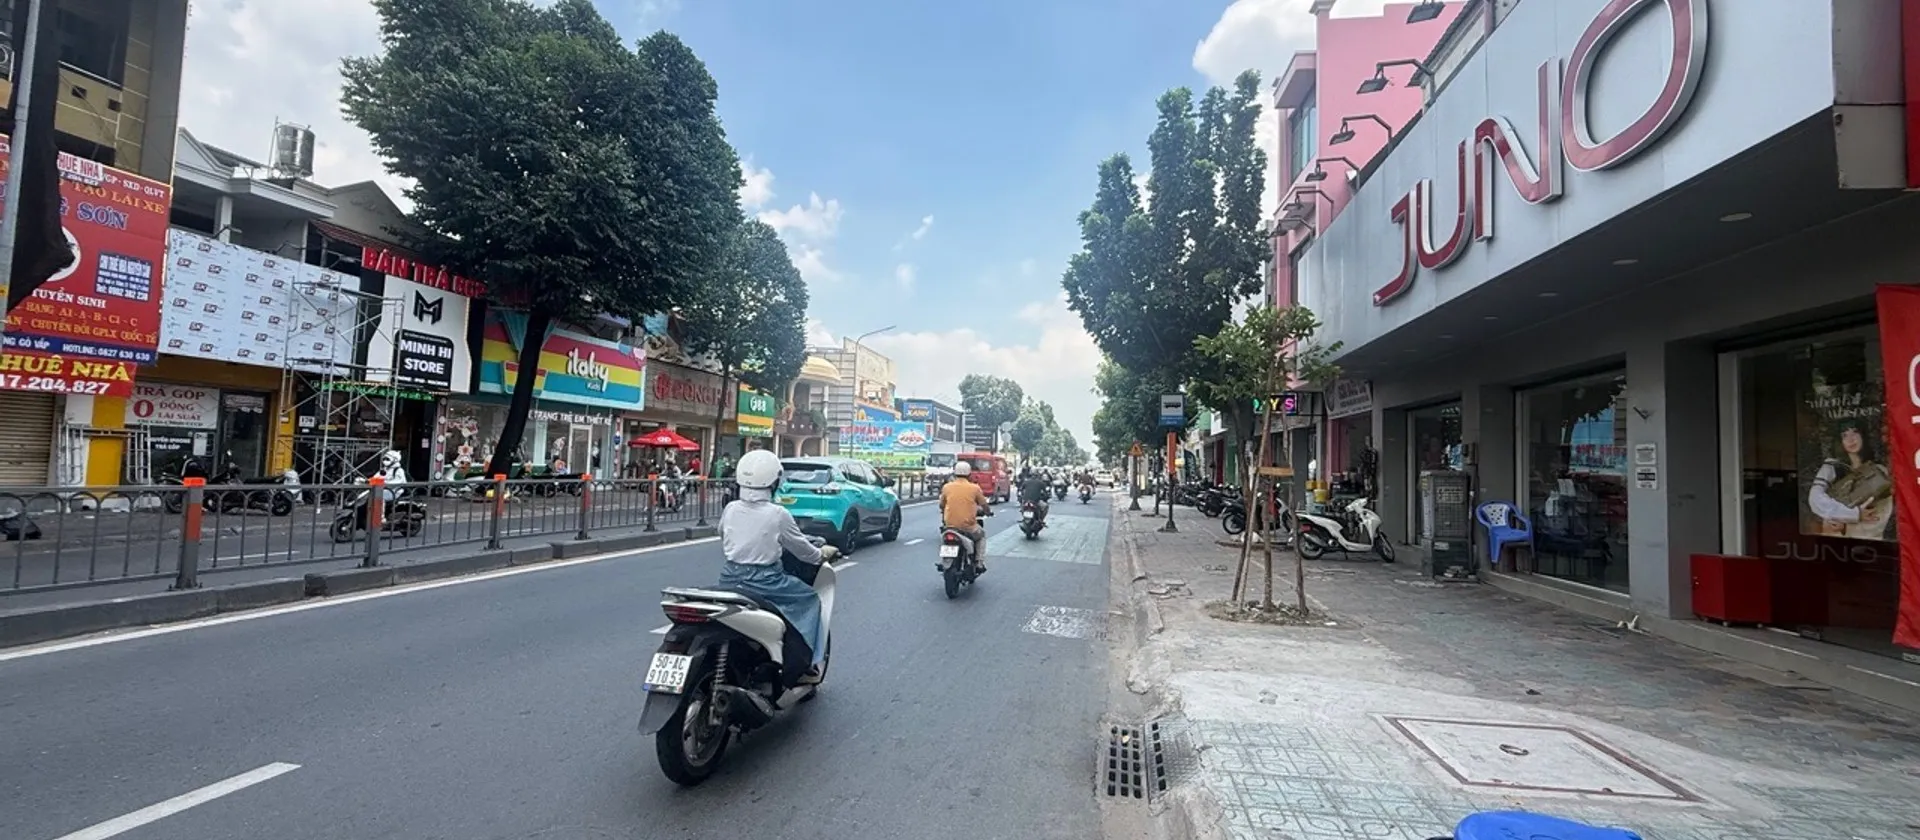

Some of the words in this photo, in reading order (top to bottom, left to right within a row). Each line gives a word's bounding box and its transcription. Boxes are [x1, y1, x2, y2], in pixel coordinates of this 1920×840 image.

[1373, 0, 1708, 307] JUNO
[76, 200, 129, 231] SƠN
[144, 199, 165, 215] XE
[361, 246, 409, 278] BÁN
[32, 286, 74, 304] TUYỂN
[77, 295, 107, 309] SINH
[400, 339, 436, 356] MINH
[437, 346, 452, 359] HI
[71, 361, 131, 381] NHÀ
[404, 357, 445, 375] STORE
[136, 384, 166, 397] TRẢ
[1764, 541, 1877, 563] JUNO
[656, 655, 687, 670] 50-AC
[648, 669, 684, 685] 91053
